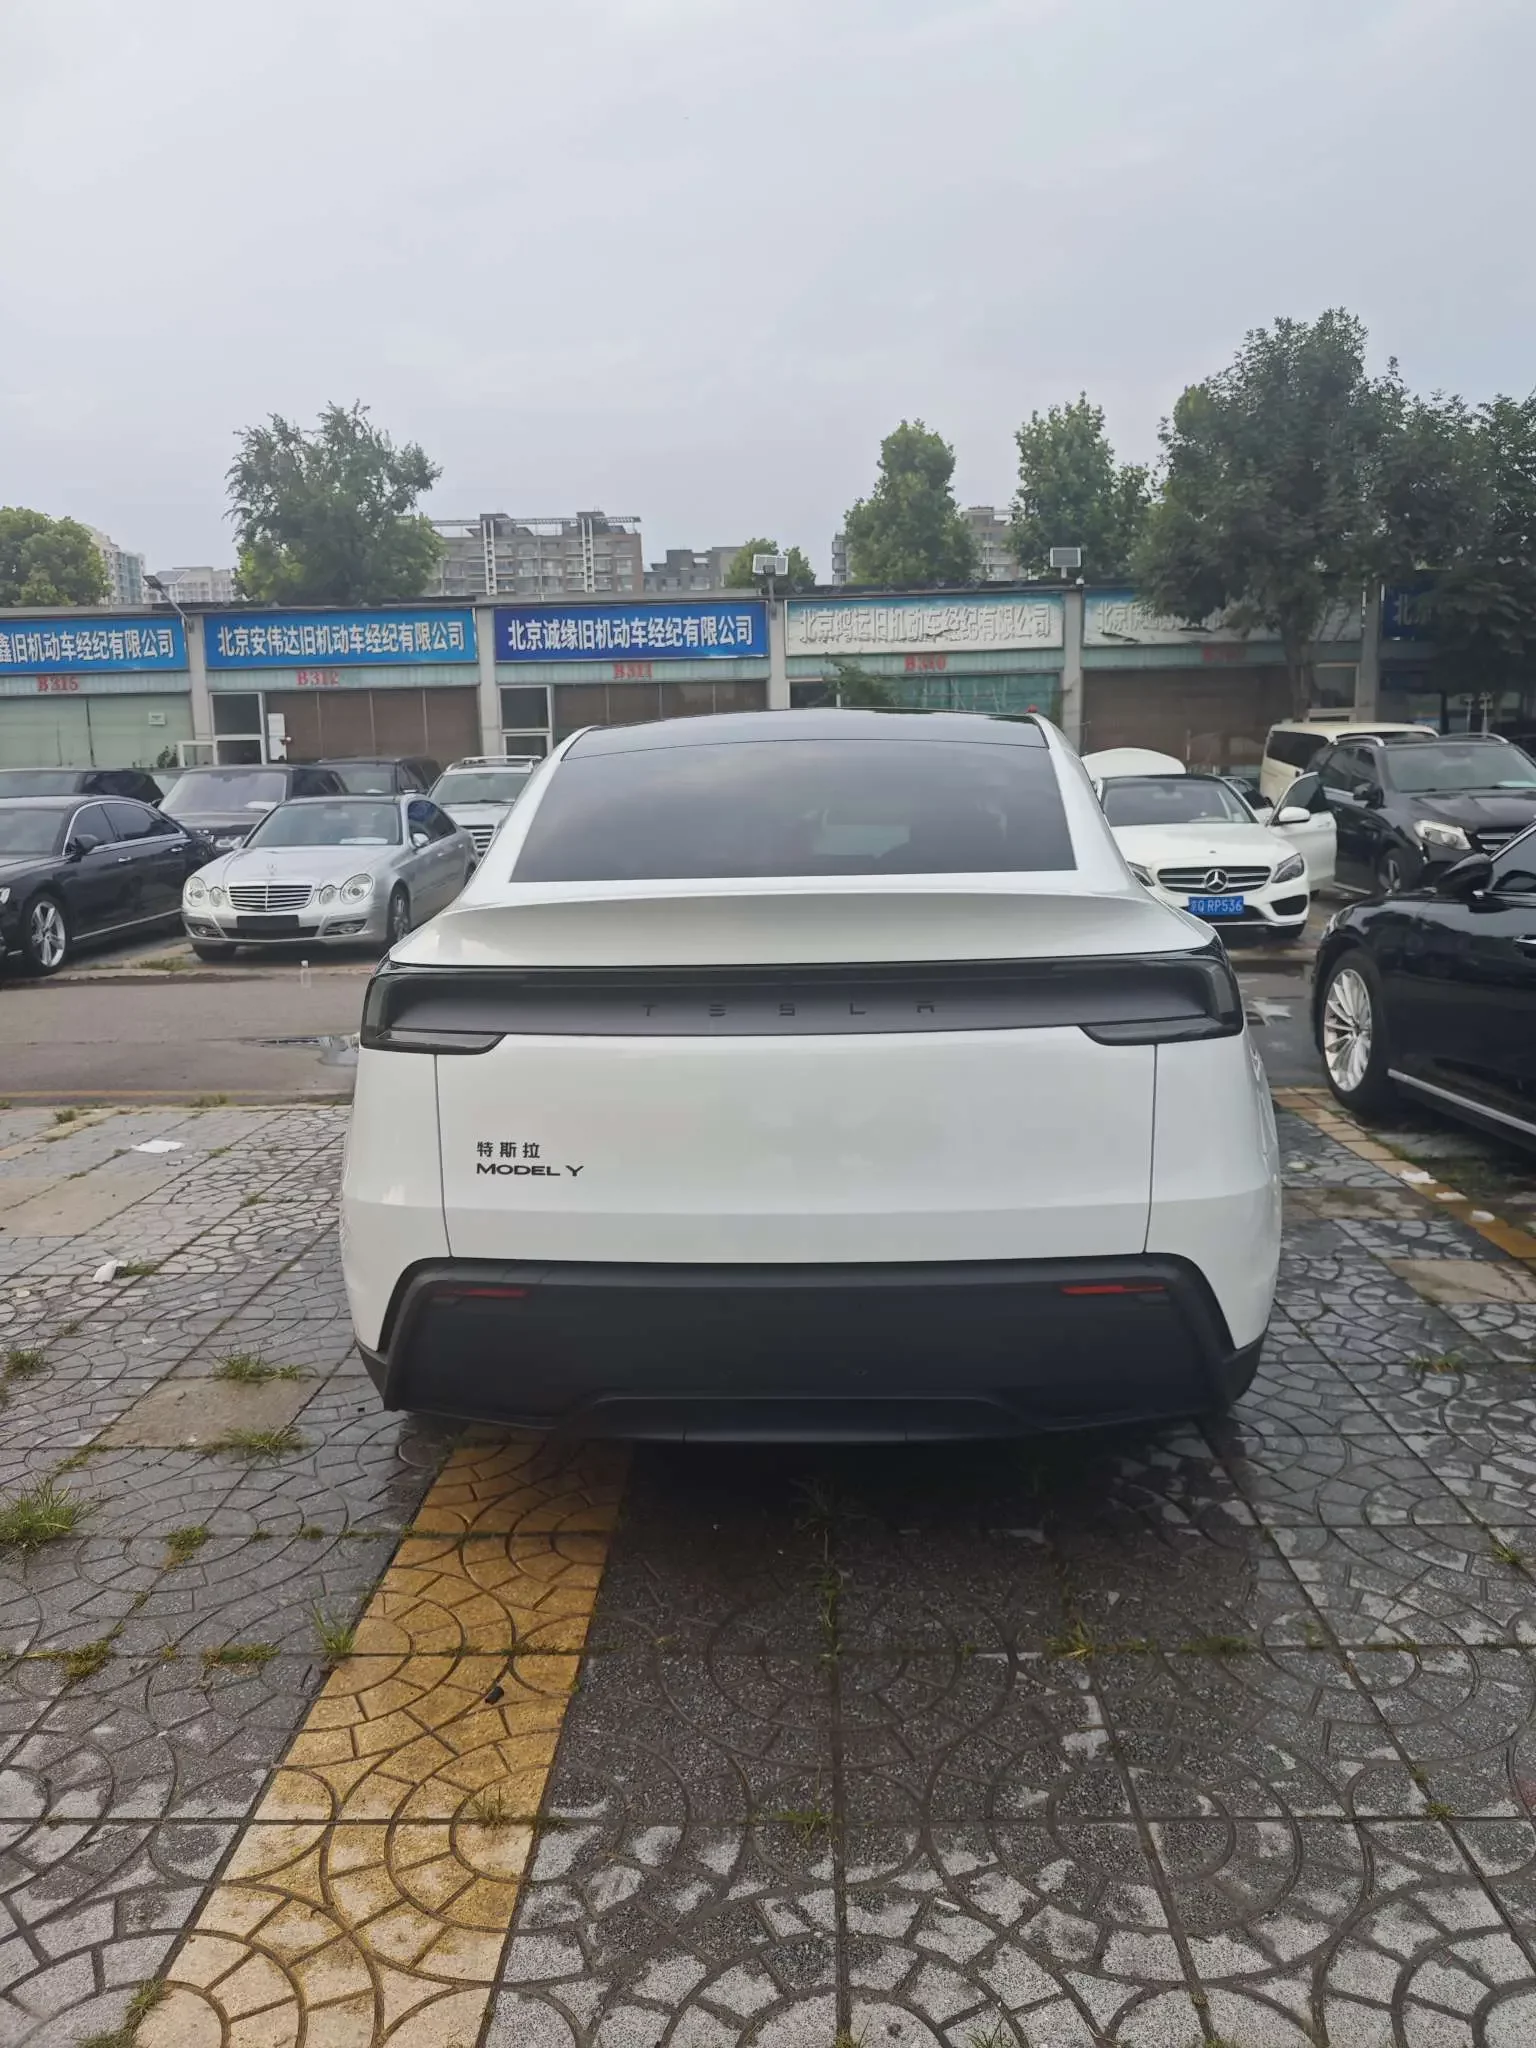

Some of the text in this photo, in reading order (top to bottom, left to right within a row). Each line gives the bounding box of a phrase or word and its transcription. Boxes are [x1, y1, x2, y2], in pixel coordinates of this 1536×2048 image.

[217, 620, 466, 657] 北京安伟达旧机动车经纪有限公司
[507, 615, 753, 651] 北京诚缘旧机动车经纪有限公司
[643, 1002, 936, 1017] TESLA
[476, 1141, 541, 1158] 特斯拉
[476, 1163, 584, 1177] MODEL Y
